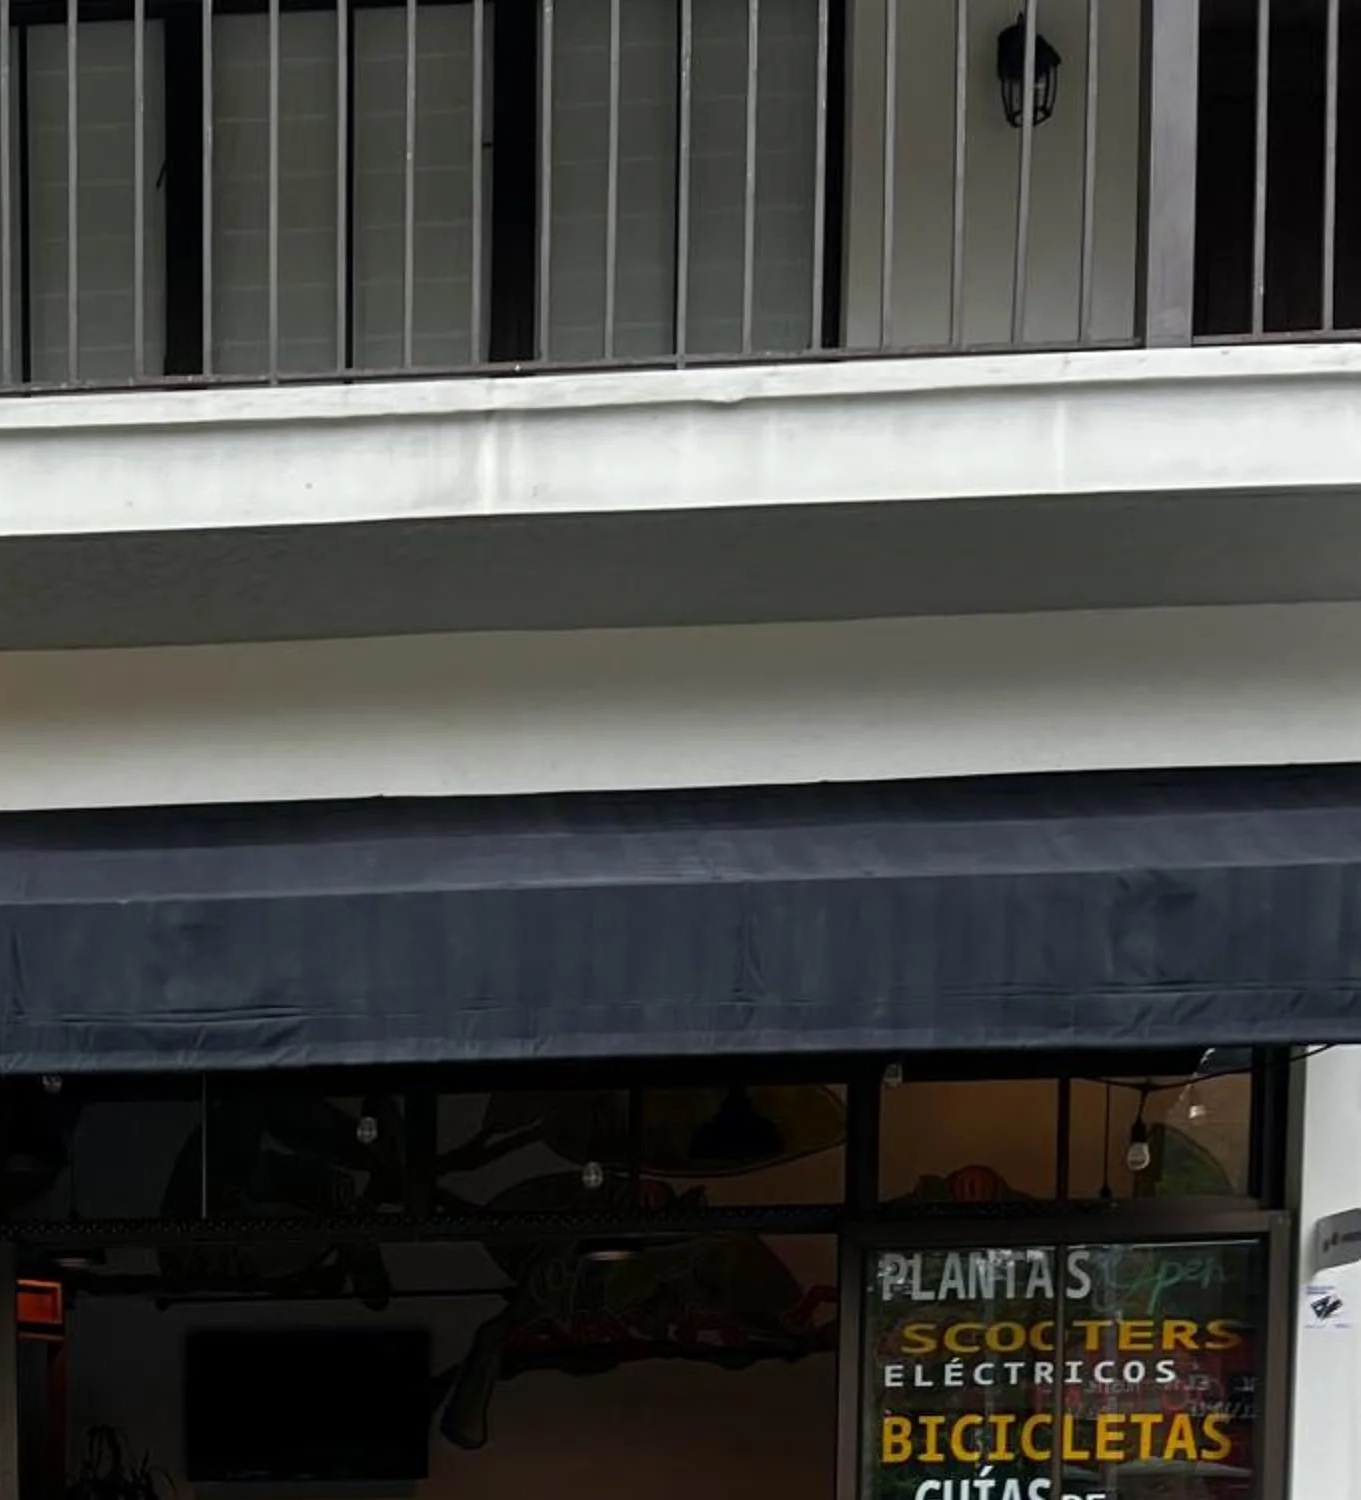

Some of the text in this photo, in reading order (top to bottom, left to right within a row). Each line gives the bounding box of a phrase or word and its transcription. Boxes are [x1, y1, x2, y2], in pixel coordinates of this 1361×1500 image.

[880, 1250, 1092, 1299] PLANTAS
[884, 1357, 1177, 1387] ELÉCTRICOS
[882, 1412, 1233, 1463] BICICLETAS
